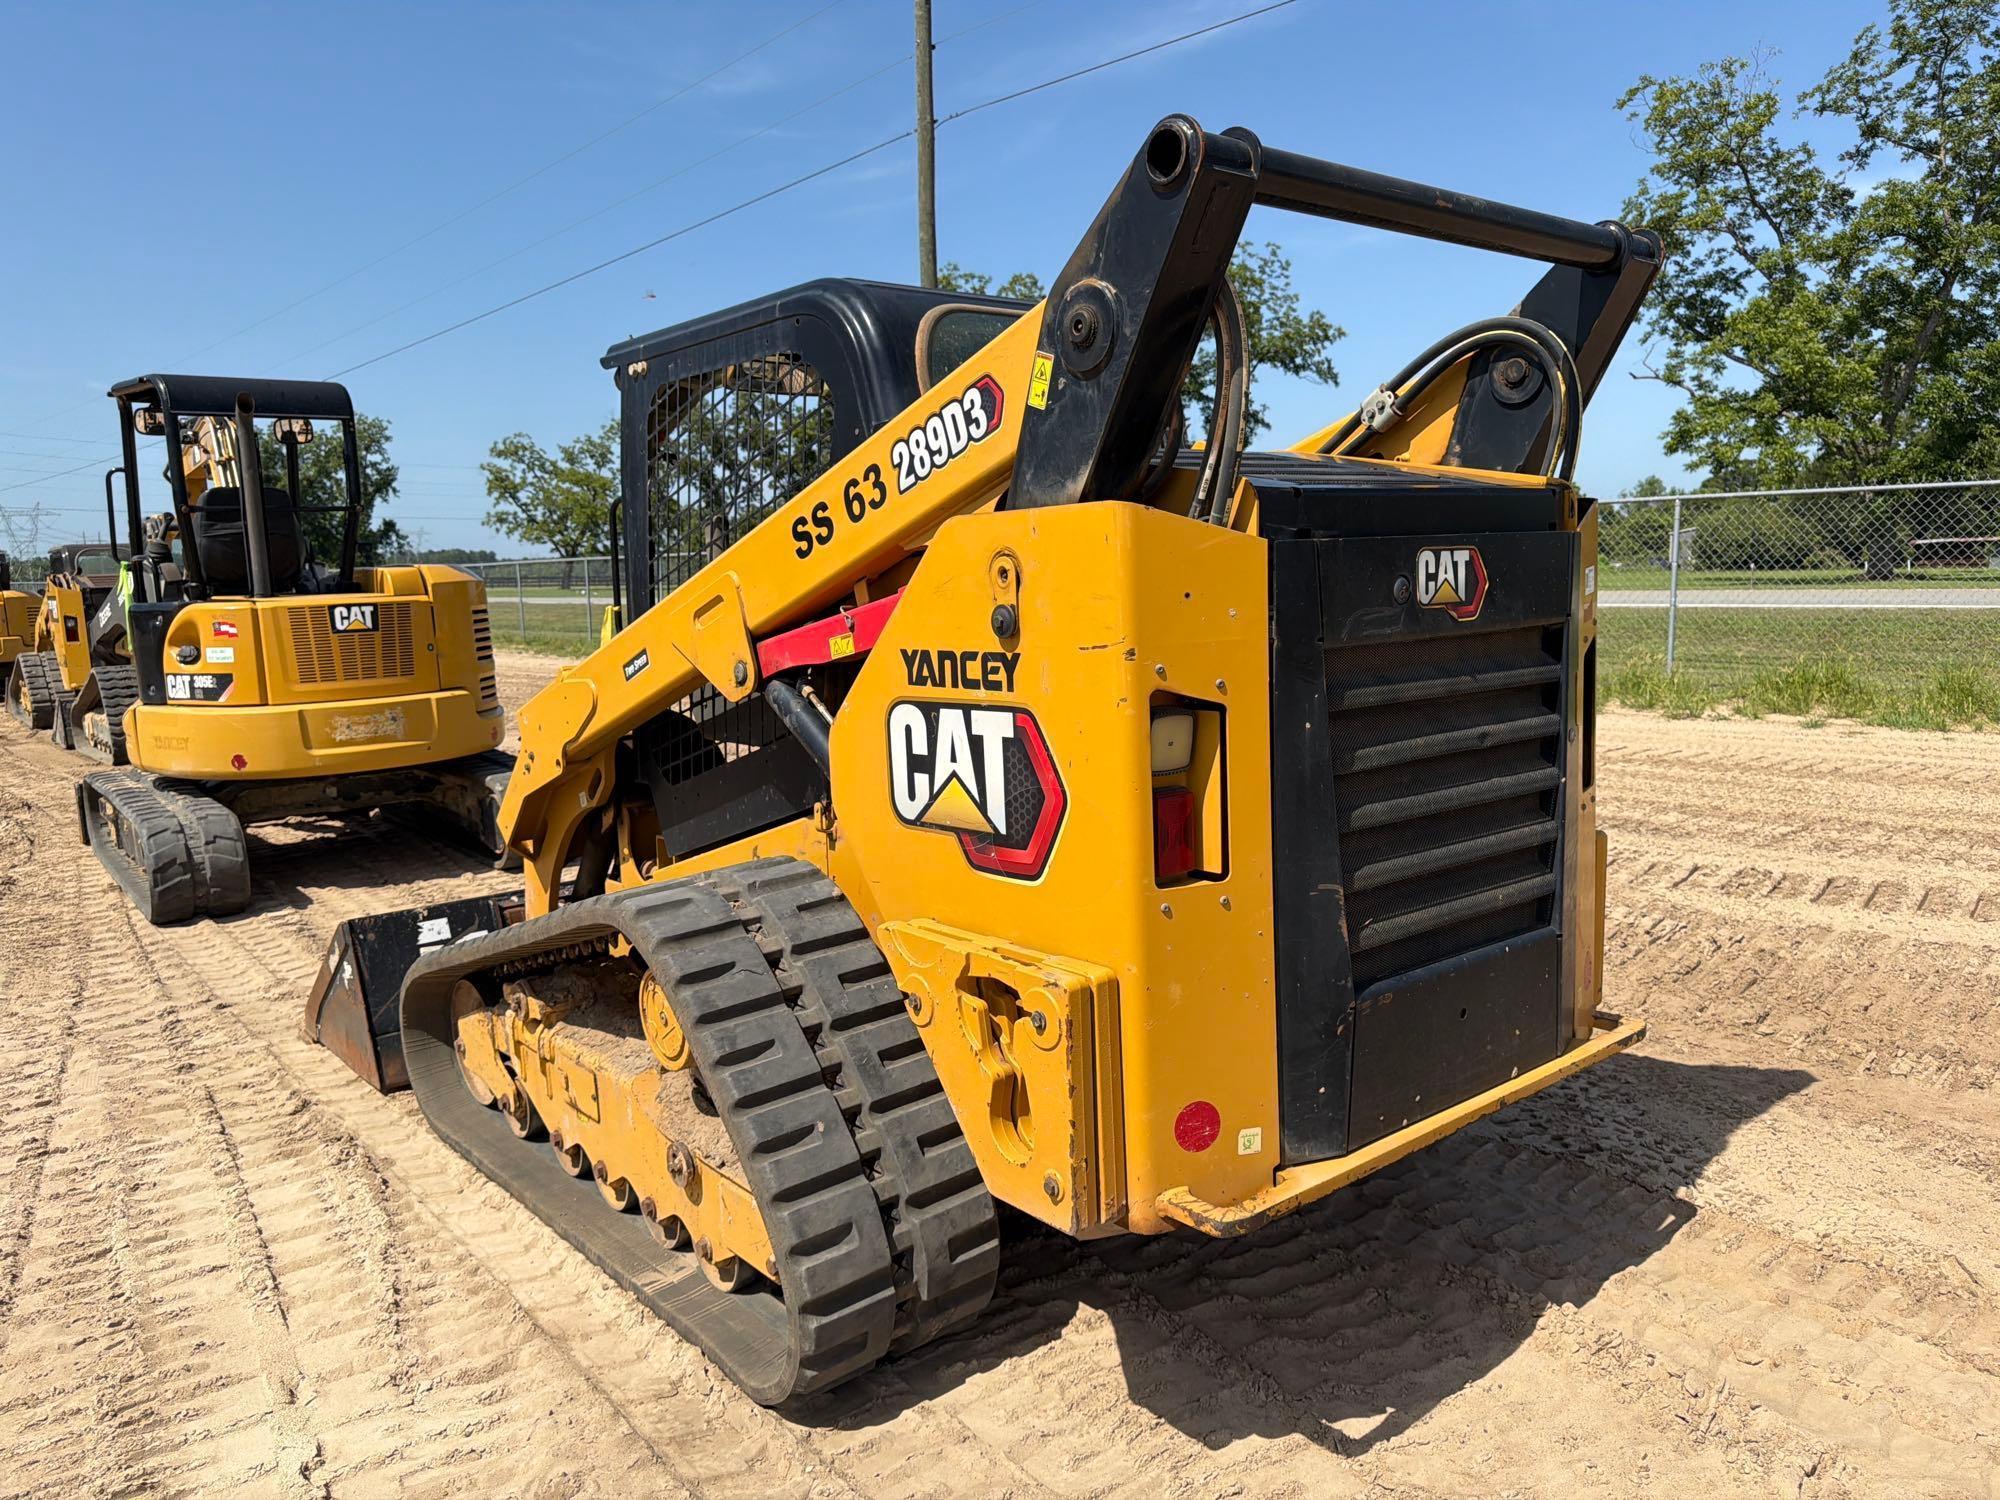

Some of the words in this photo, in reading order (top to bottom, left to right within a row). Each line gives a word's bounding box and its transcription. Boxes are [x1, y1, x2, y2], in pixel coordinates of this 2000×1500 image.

[892, 386, 988, 492] 289D3
[791, 501, 834, 559] SS
[843, 463, 887, 523] 63
[1418, 549, 1470, 605] CAT
[334, 605, 374, 631] CAT
[166, 675, 191, 699] CAT
[900, 648, 1021, 692] YANCEY
[889, 703, 1014, 836] CAT
